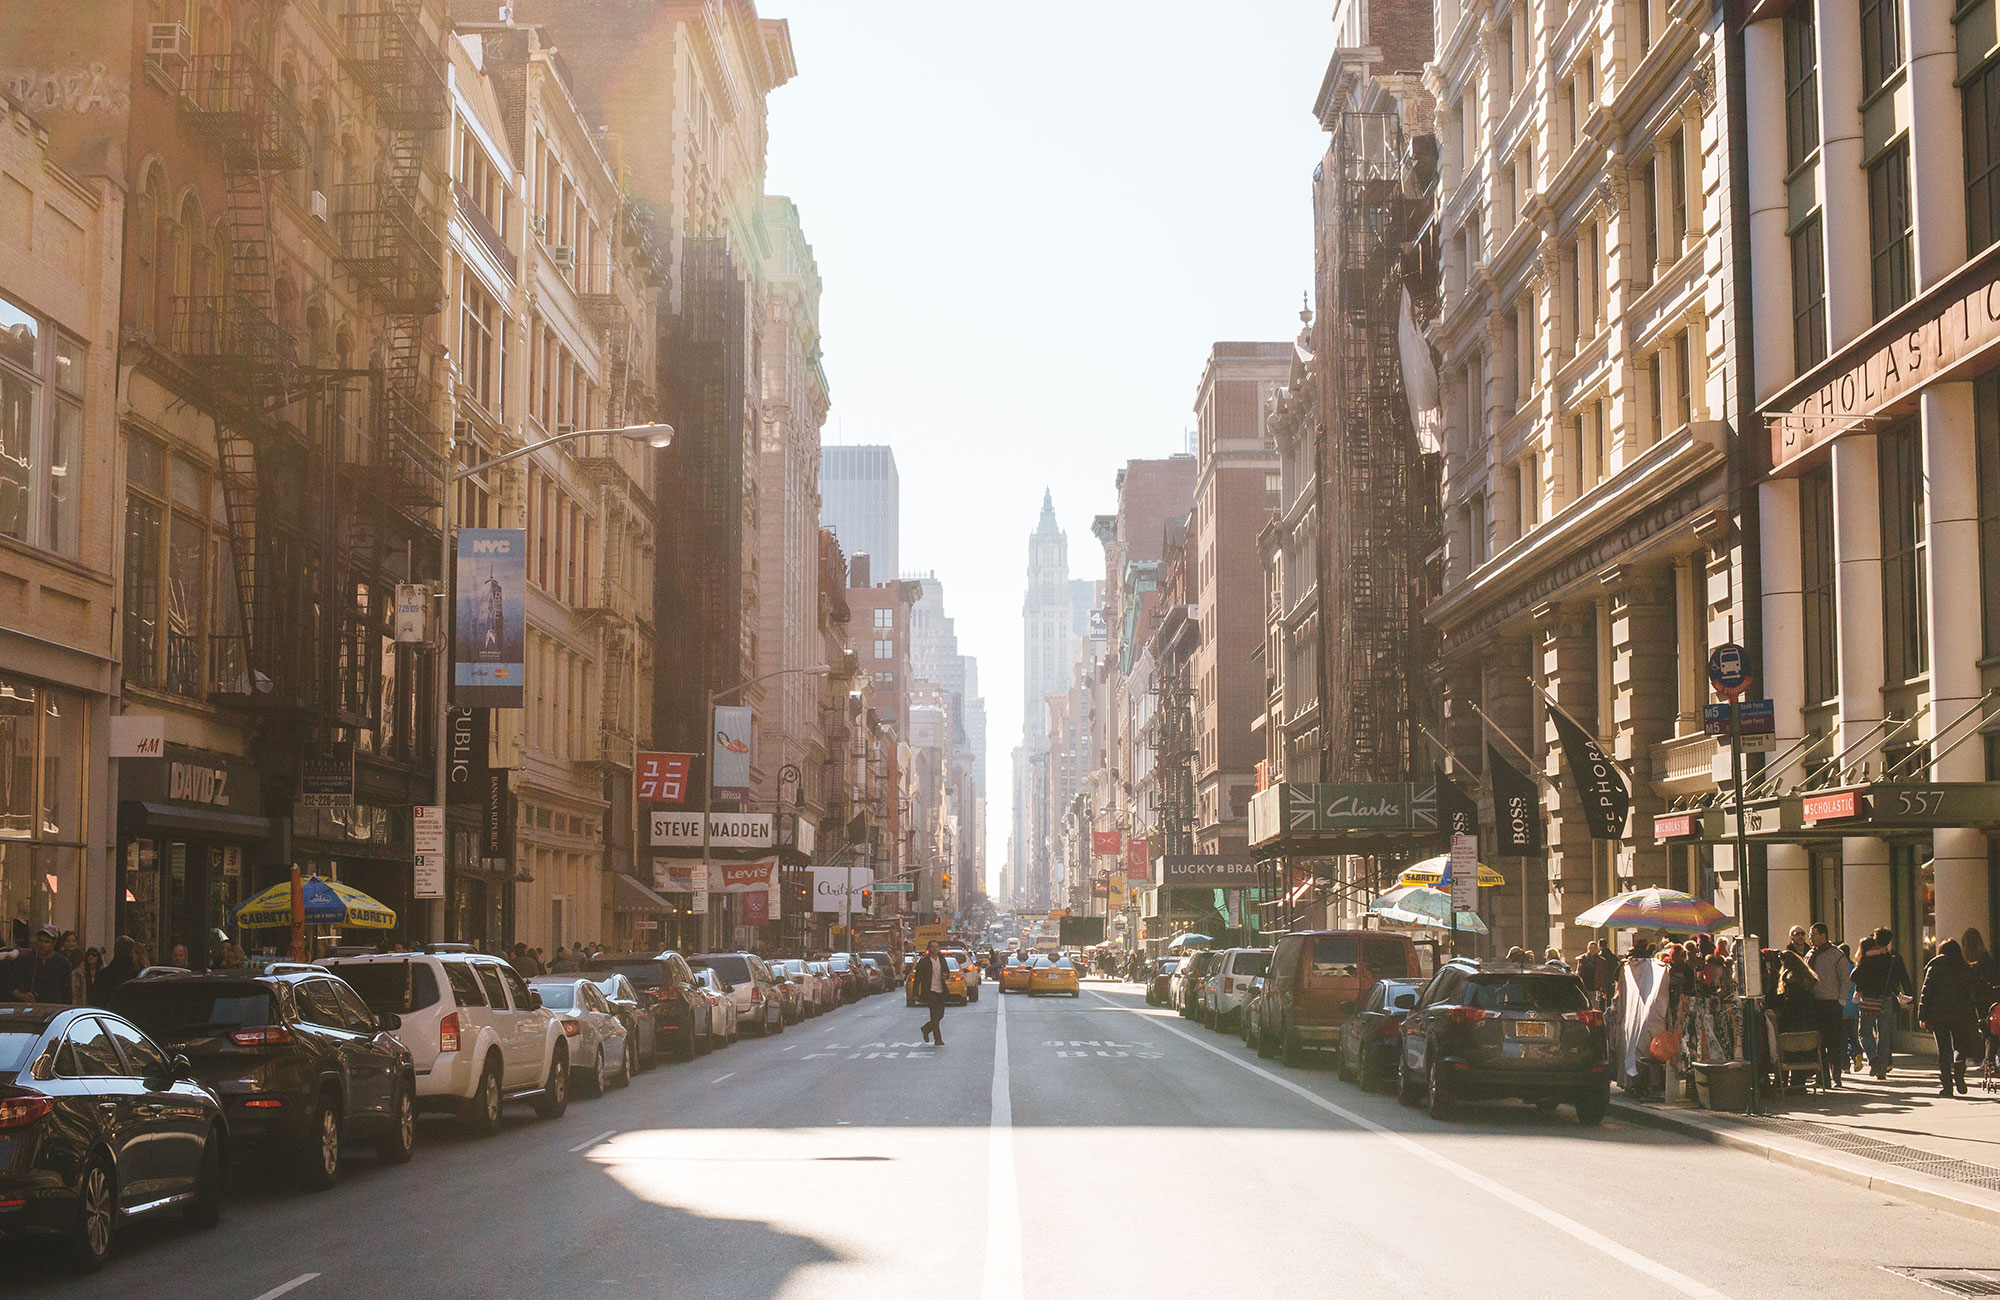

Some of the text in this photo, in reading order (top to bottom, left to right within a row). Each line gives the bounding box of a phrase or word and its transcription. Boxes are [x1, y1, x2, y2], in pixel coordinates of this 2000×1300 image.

[1785, 279, 2000, 447] SCHOLASTIC
[473, 540, 510, 553] NYC
[1704, 706, 1720, 719] M5
[1705, 722, 1721, 734] M5
[1584, 741, 1617, 833] SEPHORA
[1326, 796, 1400, 817] Clarks
[1809, 798, 1853, 816] SCHOLASTIC
[1899, 791, 1945, 815] 557
[416, 807, 422, 817] 3
[490, 776, 499, 851] BANANA REPUBLIC
[1452, 812, 1465, 836] SS
[1509, 797, 1526, 844] BOSS
[1659, 819, 1689, 833] SCHOLASTIC
[654, 821, 769, 838] STEVE MADDEN
[1452, 837, 1457, 845] 3
[417, 856, 423, 866] 2
[1171, 864, 1215, 874] LUCKY
[1405, 874, 1441, 884] SABRETT
[1453, 879, 1458, 887] 2
[1478, 875, 1504, 885] ABRETT
[817, 880, 861, 896] Aritzia
[240, 911, 291, 926] SABRETT
[350, 908, 395, 925] SABRETT
[1042, 1040, 1155, 1048] ONLY
[800, 1052, 937, 1060] FIRE
[1055, 1051, 1166, 1059] BUS
